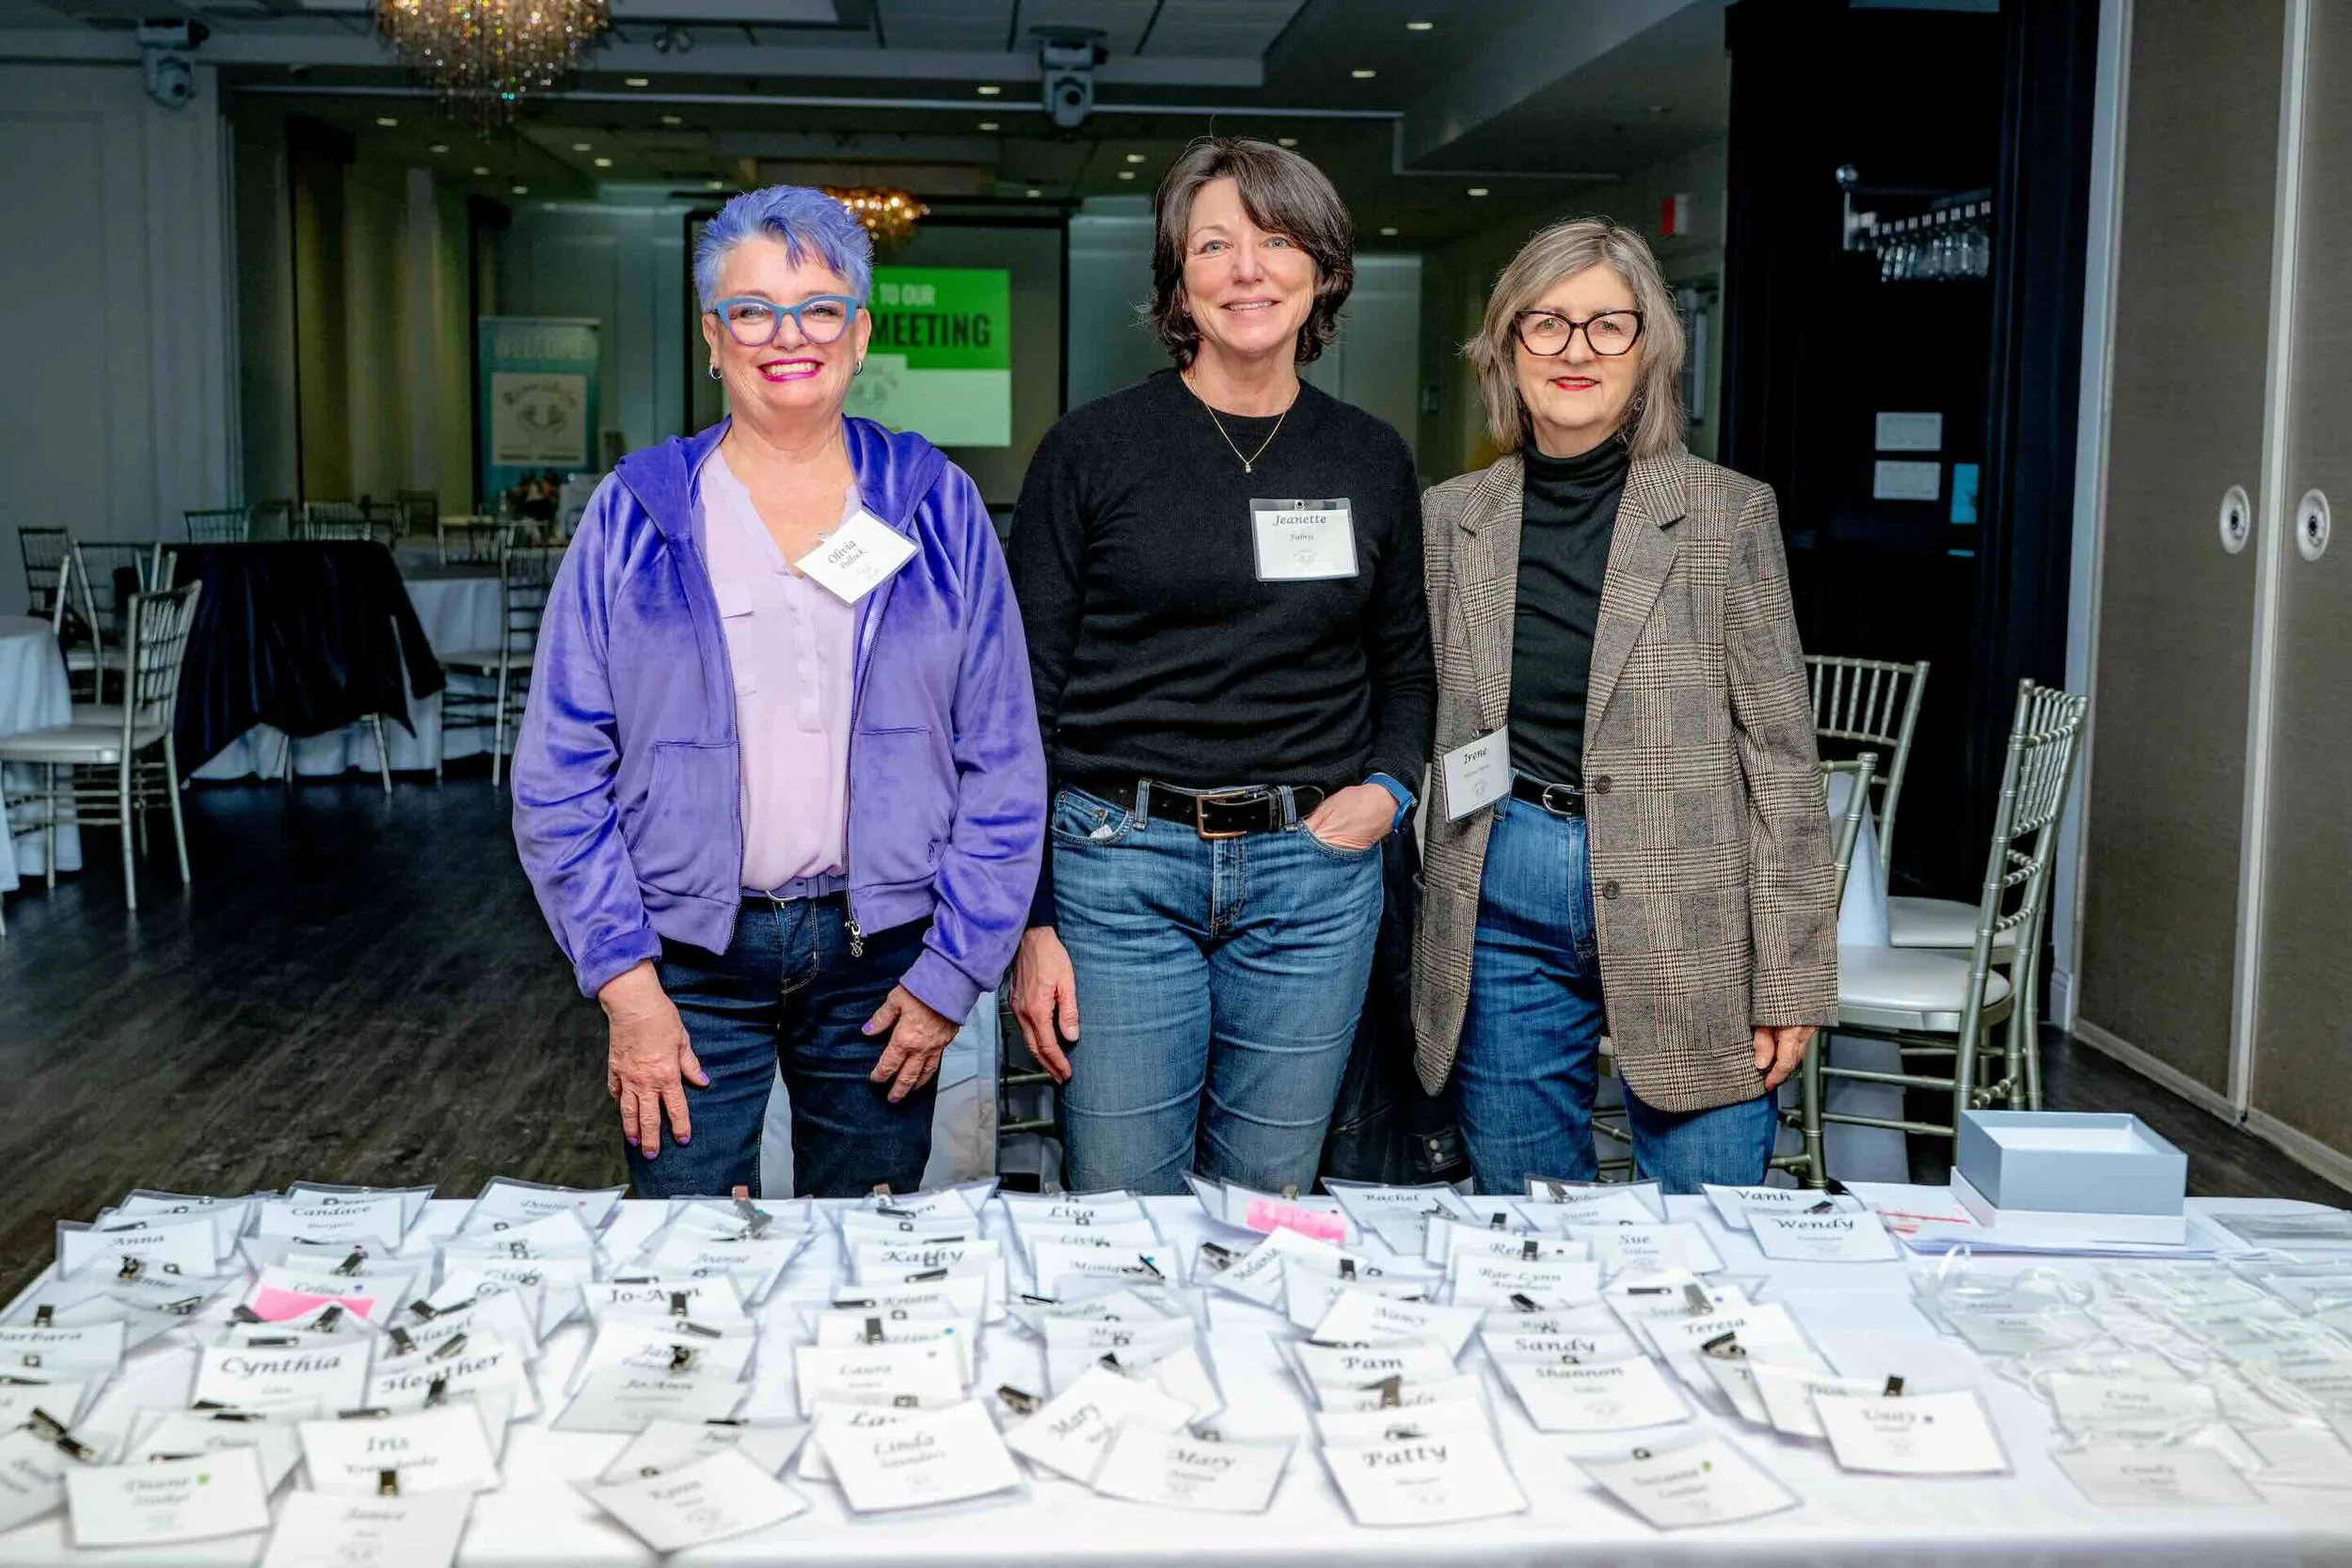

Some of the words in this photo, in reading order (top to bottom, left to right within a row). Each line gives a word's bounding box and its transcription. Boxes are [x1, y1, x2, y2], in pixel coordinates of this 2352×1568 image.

[873, 312, 991, 348] MEETING
[1273, 515, 1327, 527] Jeanette
[828, 539, 857, 564] Olivia
[1363, 1193, 1421, 1202] Rachel
[1771, 1217, 1854, 1232] Wendy
[1515, 1338, 1597, 1354] Sandy
[220, 1354, 342, 1378] Cynthia
[1341, 1356, 1404, 1370] Pam
[366, 1436, 411, 1453] Iris
[1361, 1444, 1449, 1469] Patty
